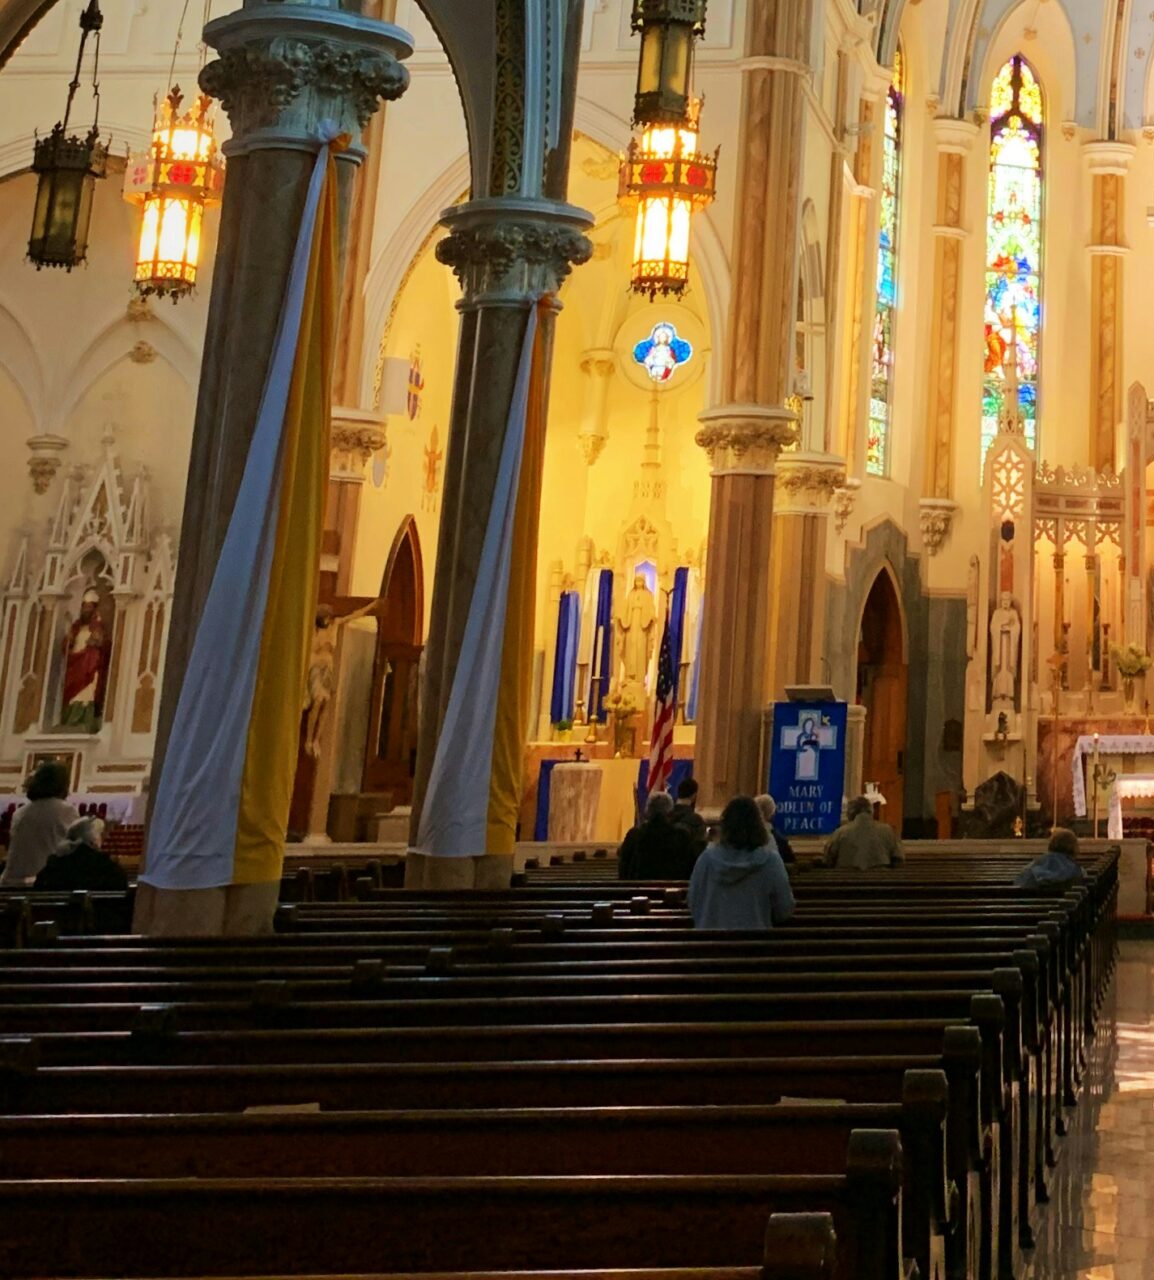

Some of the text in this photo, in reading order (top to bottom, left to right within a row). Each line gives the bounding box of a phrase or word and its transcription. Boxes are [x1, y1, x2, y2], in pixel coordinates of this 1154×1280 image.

[789, 785, 824, 798] MARY
[776, 801, 833, 814] QUEEN OF
[784, 817, 824, 830] PEACE
